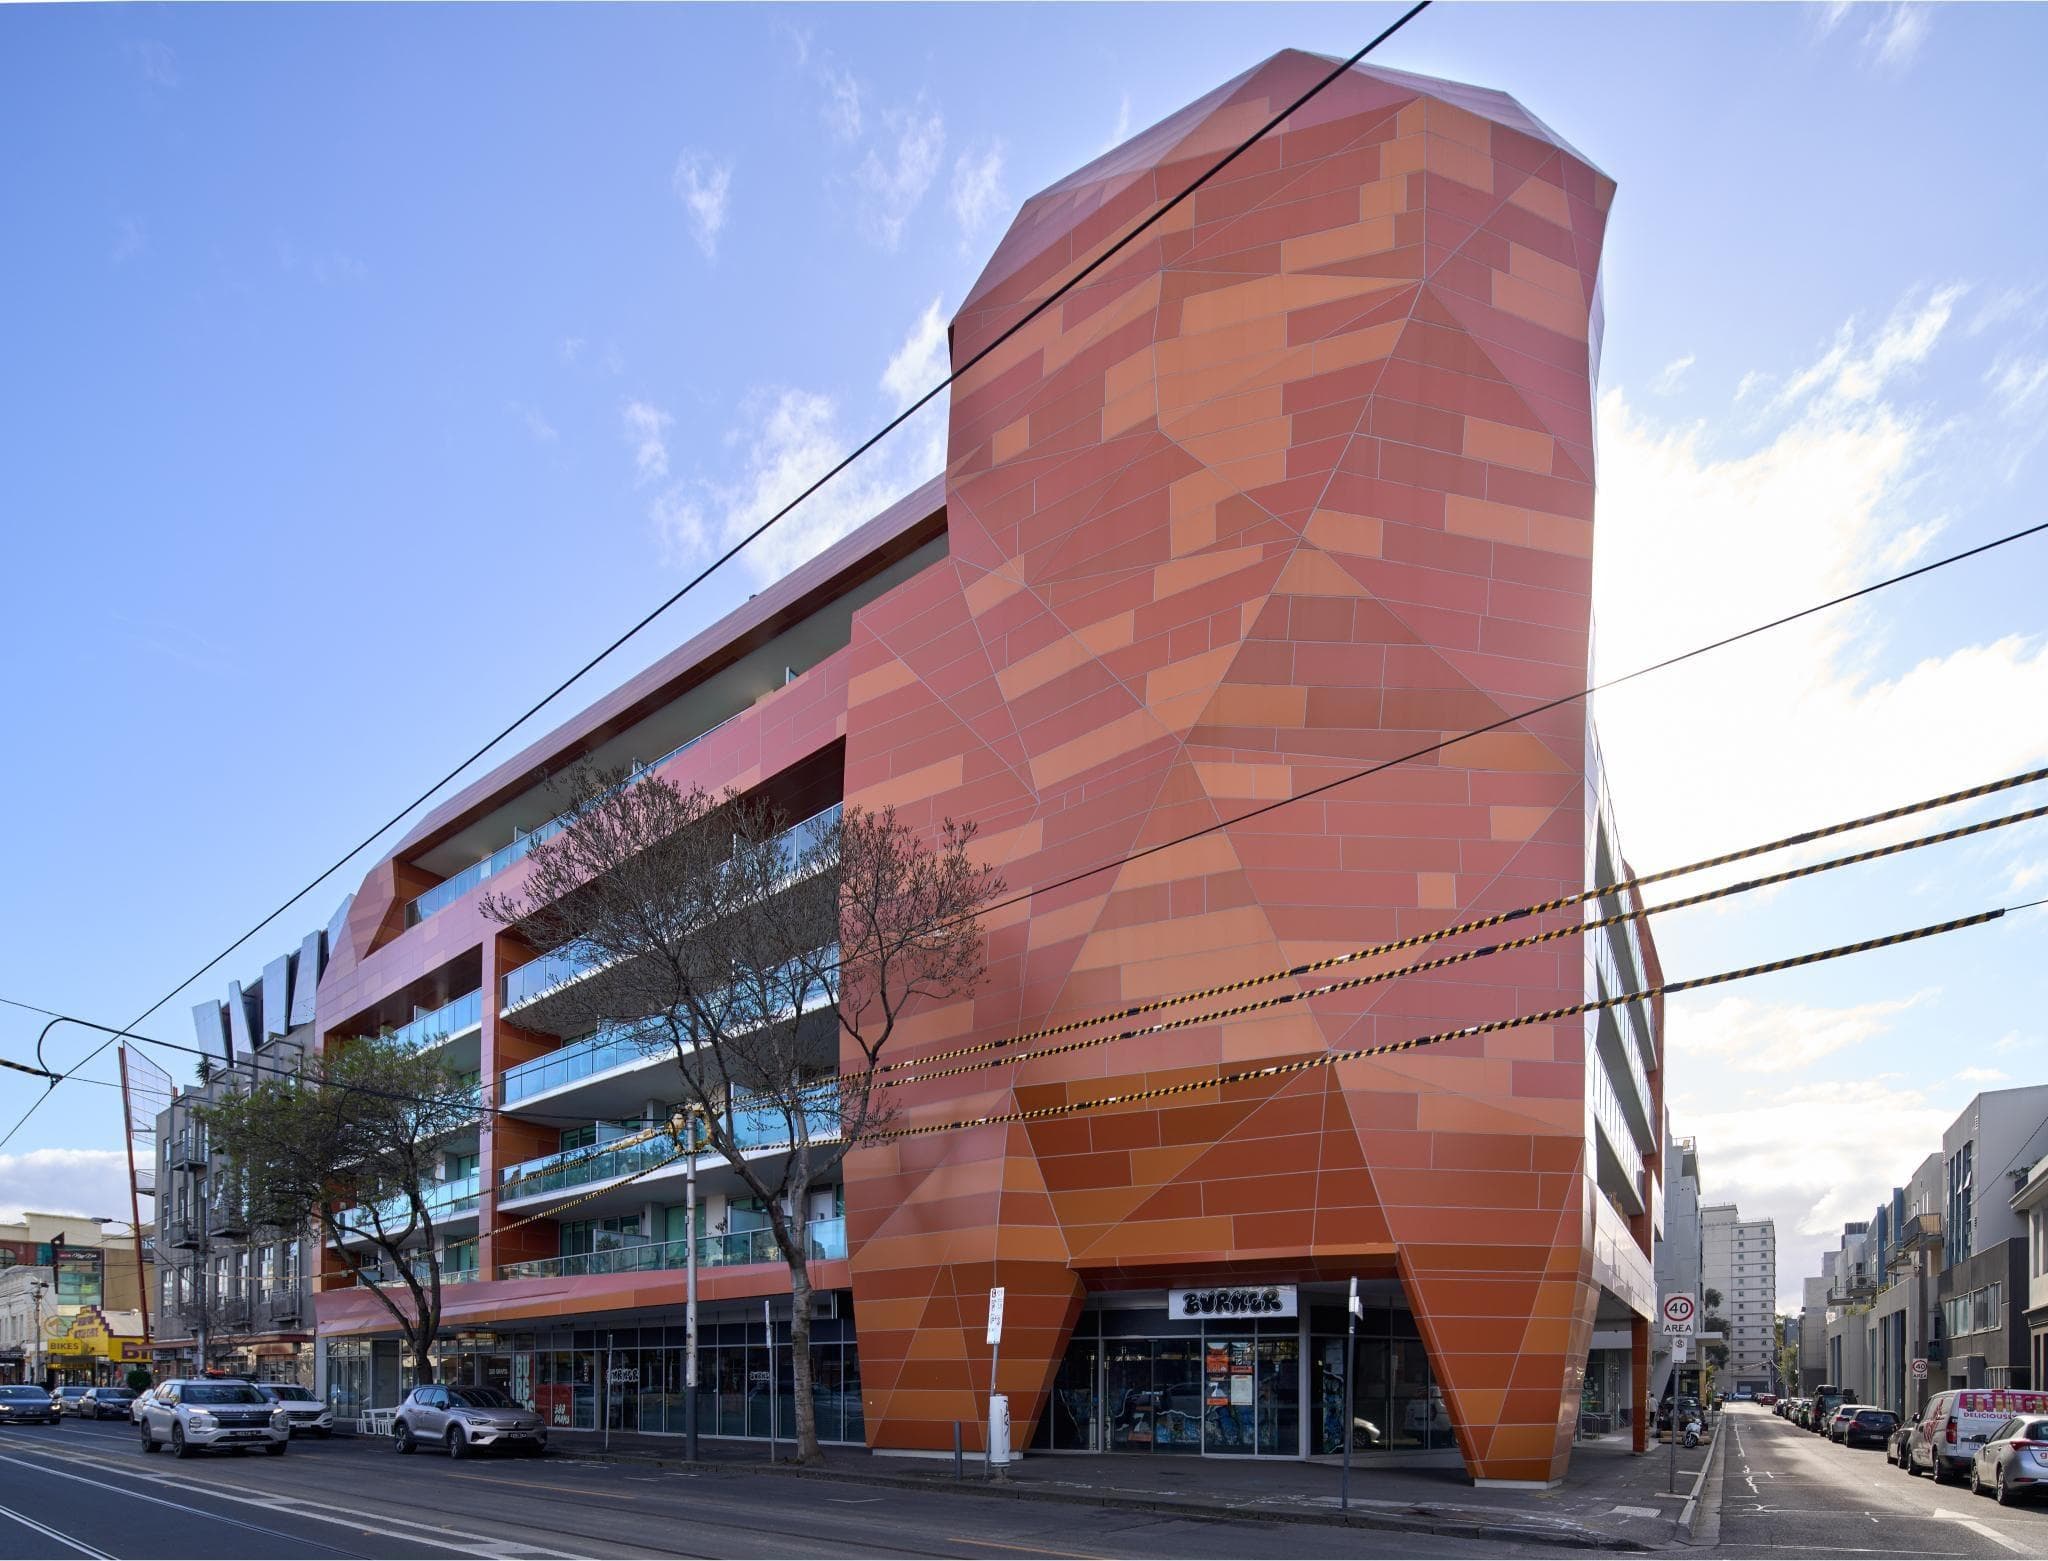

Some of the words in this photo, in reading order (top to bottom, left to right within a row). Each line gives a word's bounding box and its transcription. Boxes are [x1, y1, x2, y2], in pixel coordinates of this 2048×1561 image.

[1183, 1289, 1283, 1316] BURNER
[1669, 1302, 1689, 1314] 40
[1664, 1324, 1692, 1332] AREA
[50, 1342, 79, 1350] BIKES
